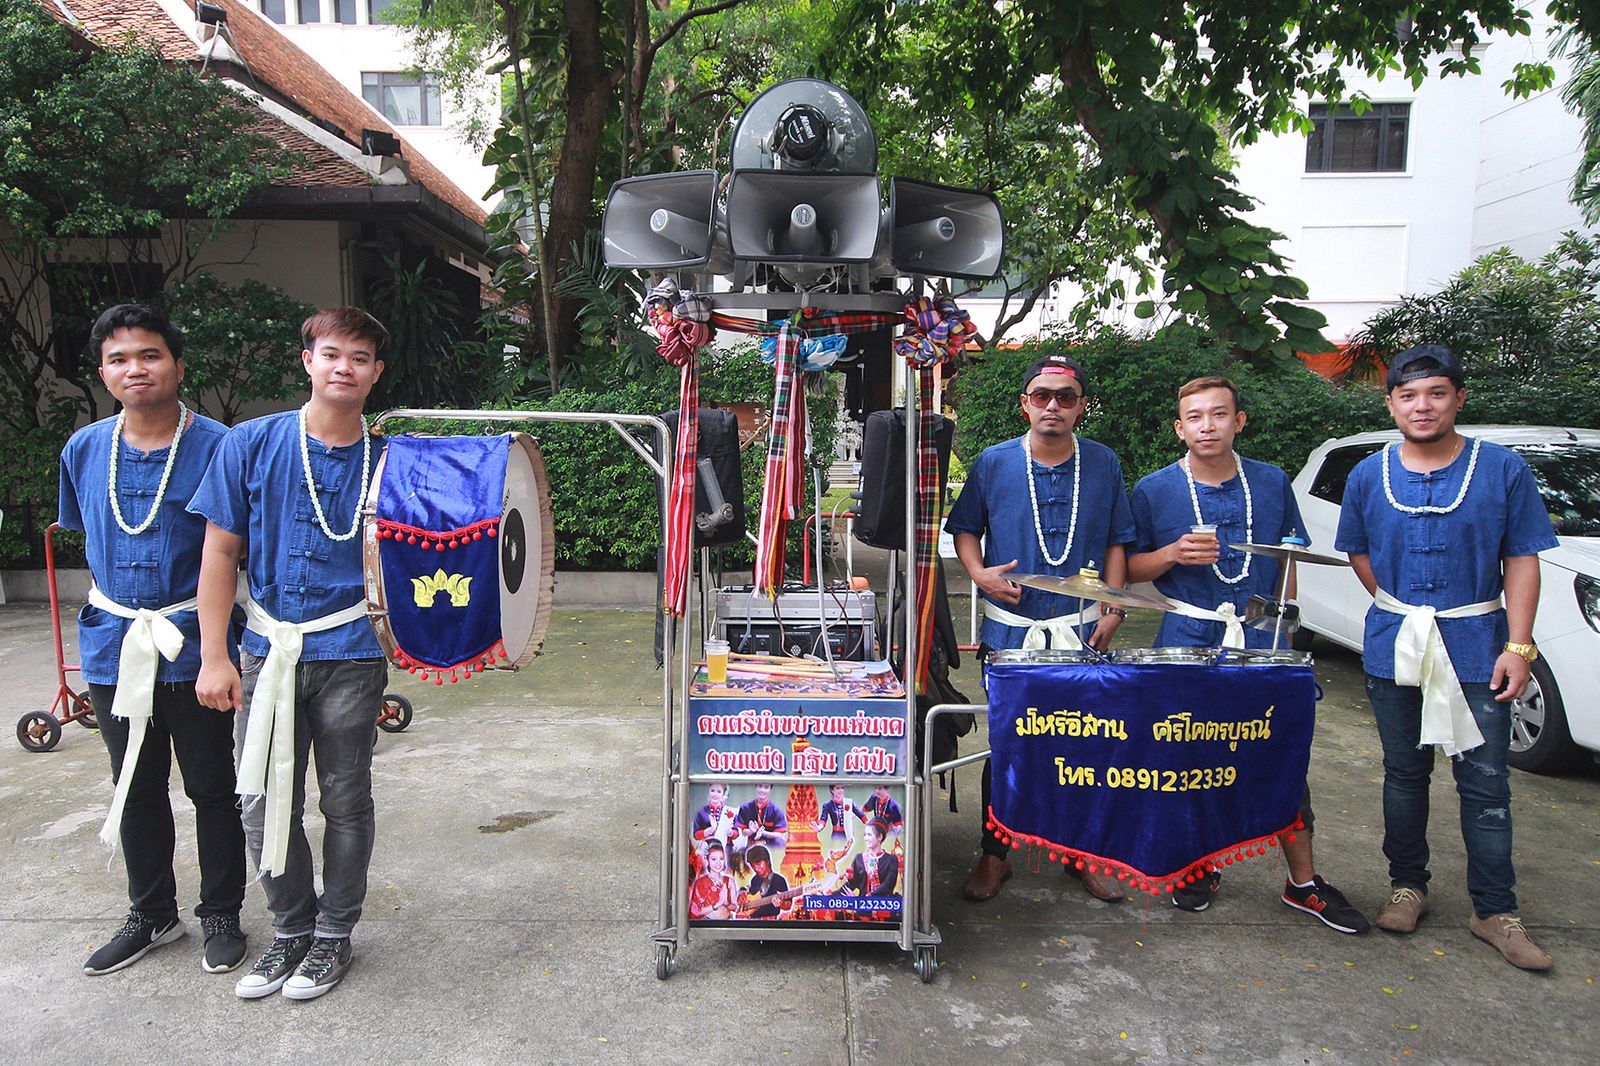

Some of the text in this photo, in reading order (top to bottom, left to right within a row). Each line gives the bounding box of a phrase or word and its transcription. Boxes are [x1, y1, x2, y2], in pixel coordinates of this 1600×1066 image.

[698, 710, 904, 735] ดนตรีนำขบวนแห่นาค
[1015, 705, 1275, 752] มโหรีอีสาน ศรีโคตรบูรณ์
[706, 746, 895, 775] งานแต่ง กฐิน ผ้าป่า
[1054, 757, 1237, 792] โทร. 0891232339
[805, 896, 901, 910] โทร. 089-1232339
[1305, 893, 1327, 913] N
